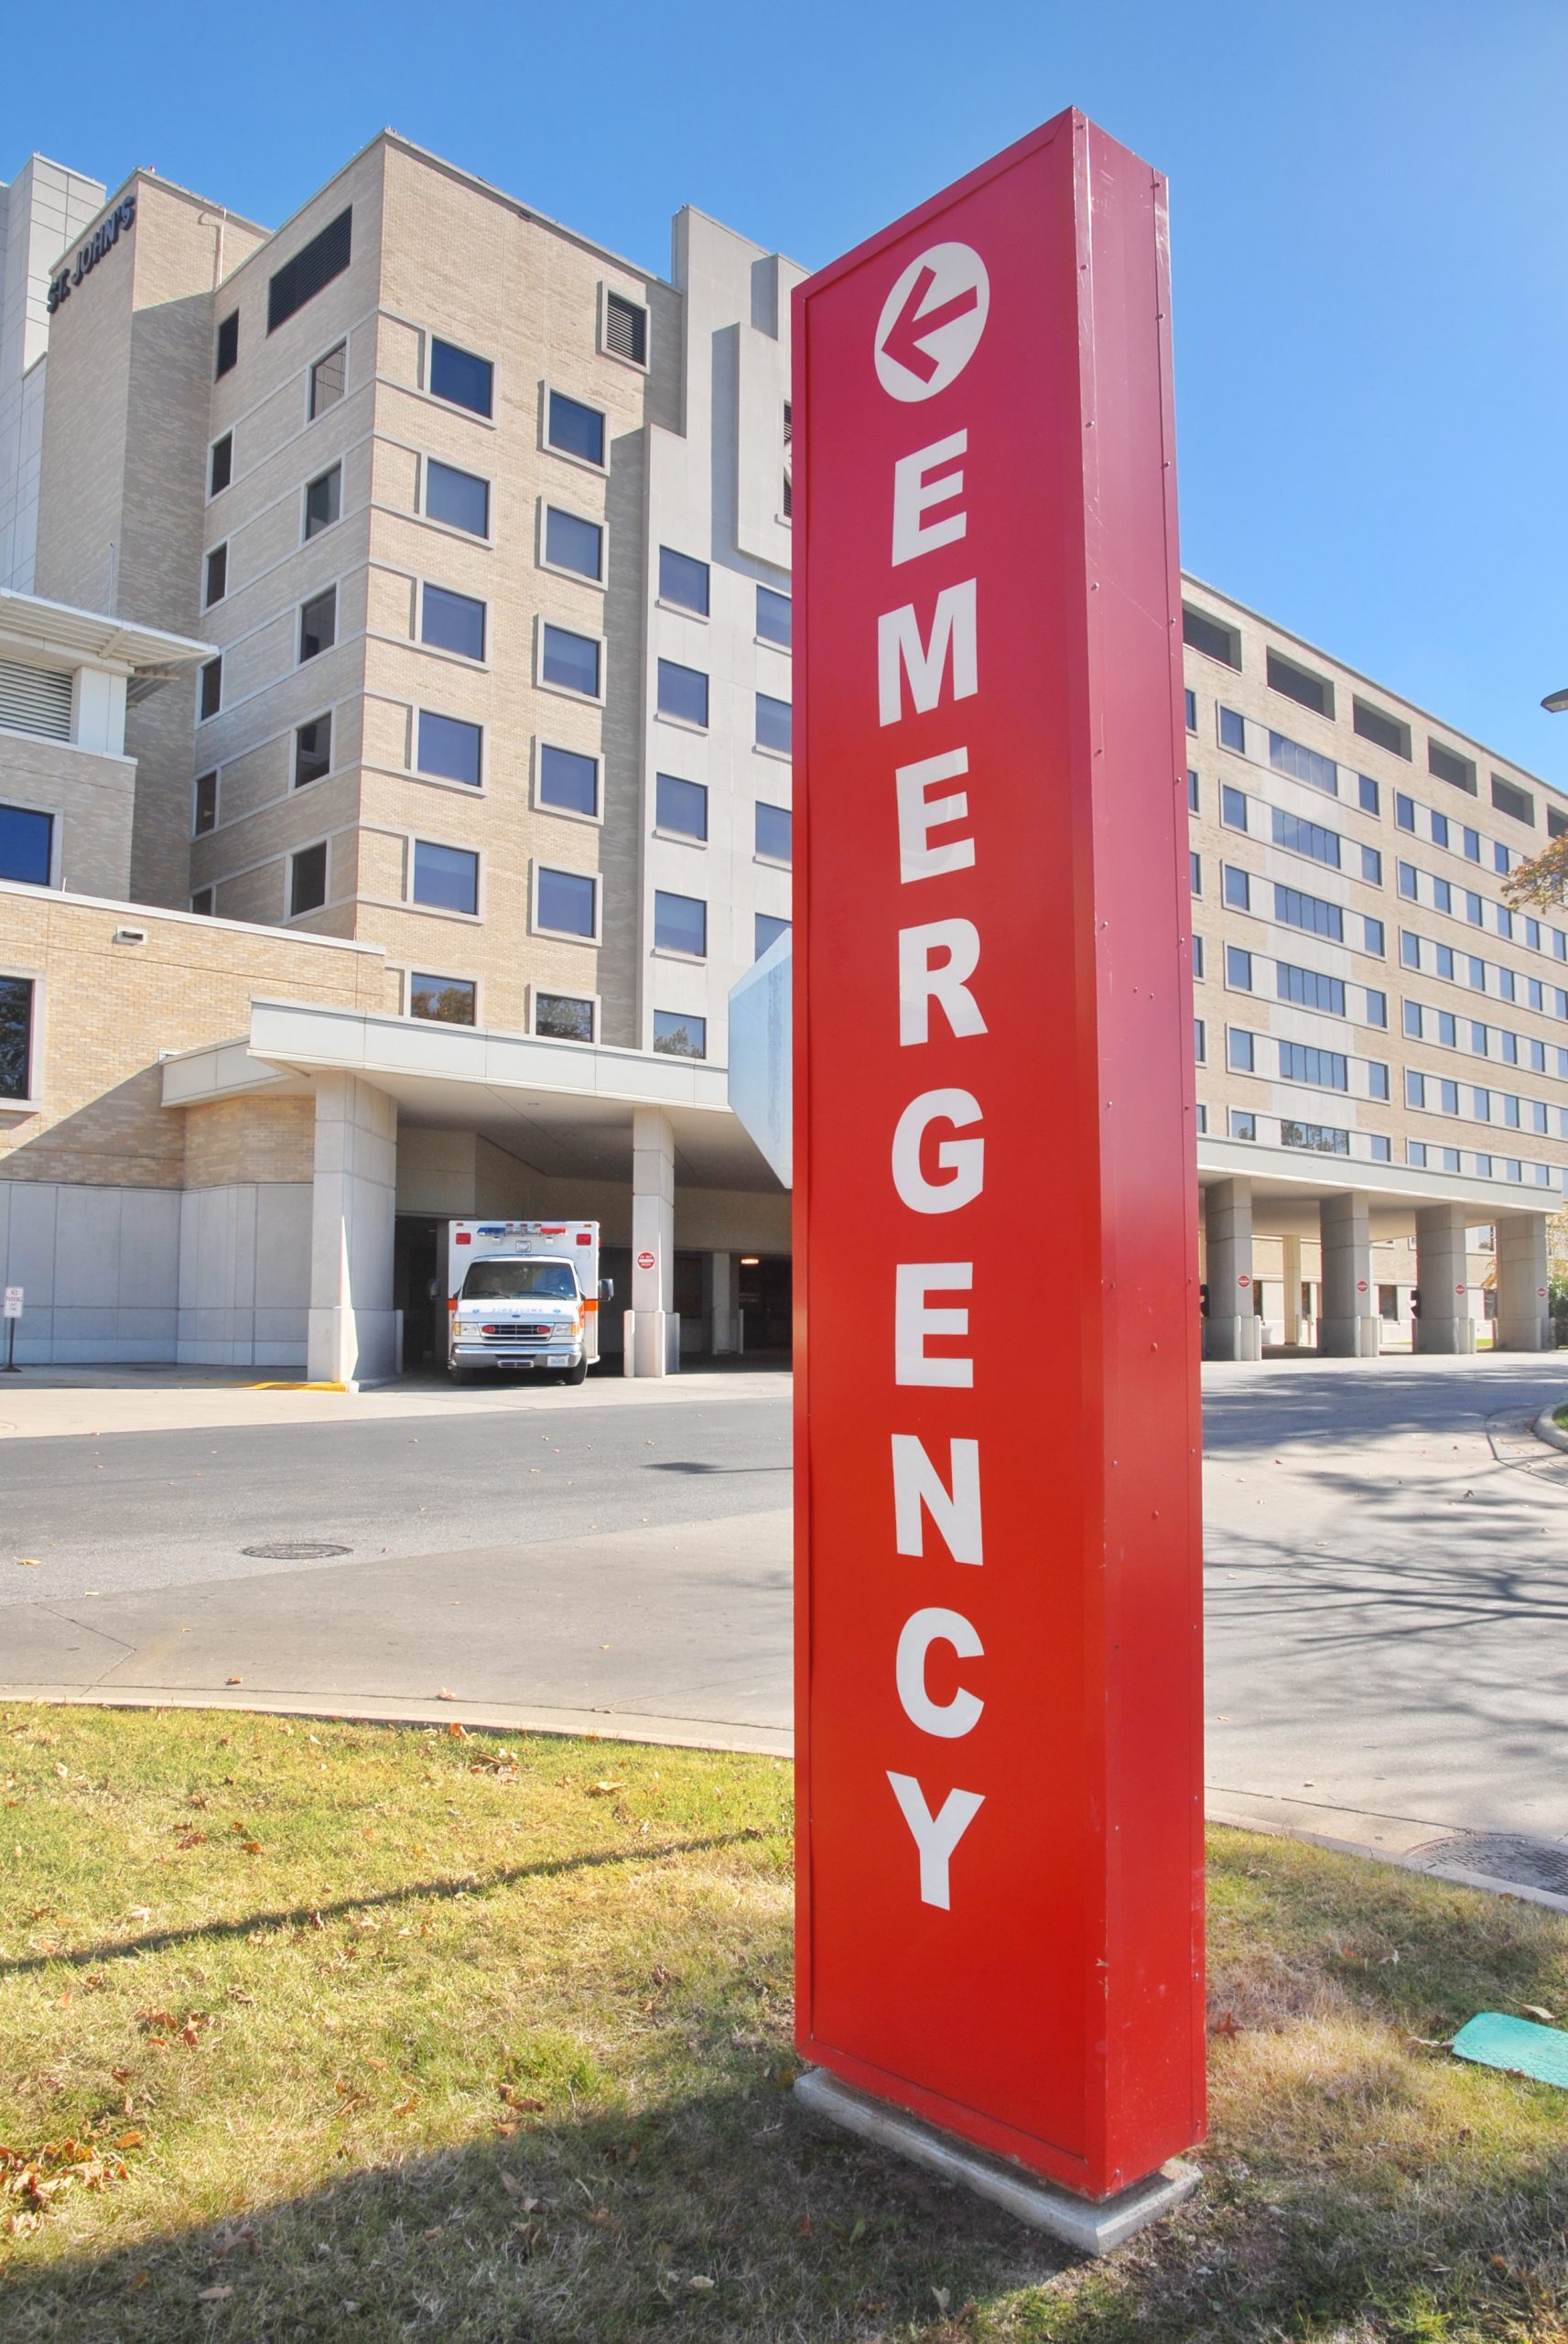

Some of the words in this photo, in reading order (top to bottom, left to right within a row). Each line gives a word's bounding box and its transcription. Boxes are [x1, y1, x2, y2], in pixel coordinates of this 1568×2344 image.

[47, 267, 70, 314] ST.
[71, 195, 135, 287] JOHN'S
[875, 428, 989, 1911] EMERGENCY
